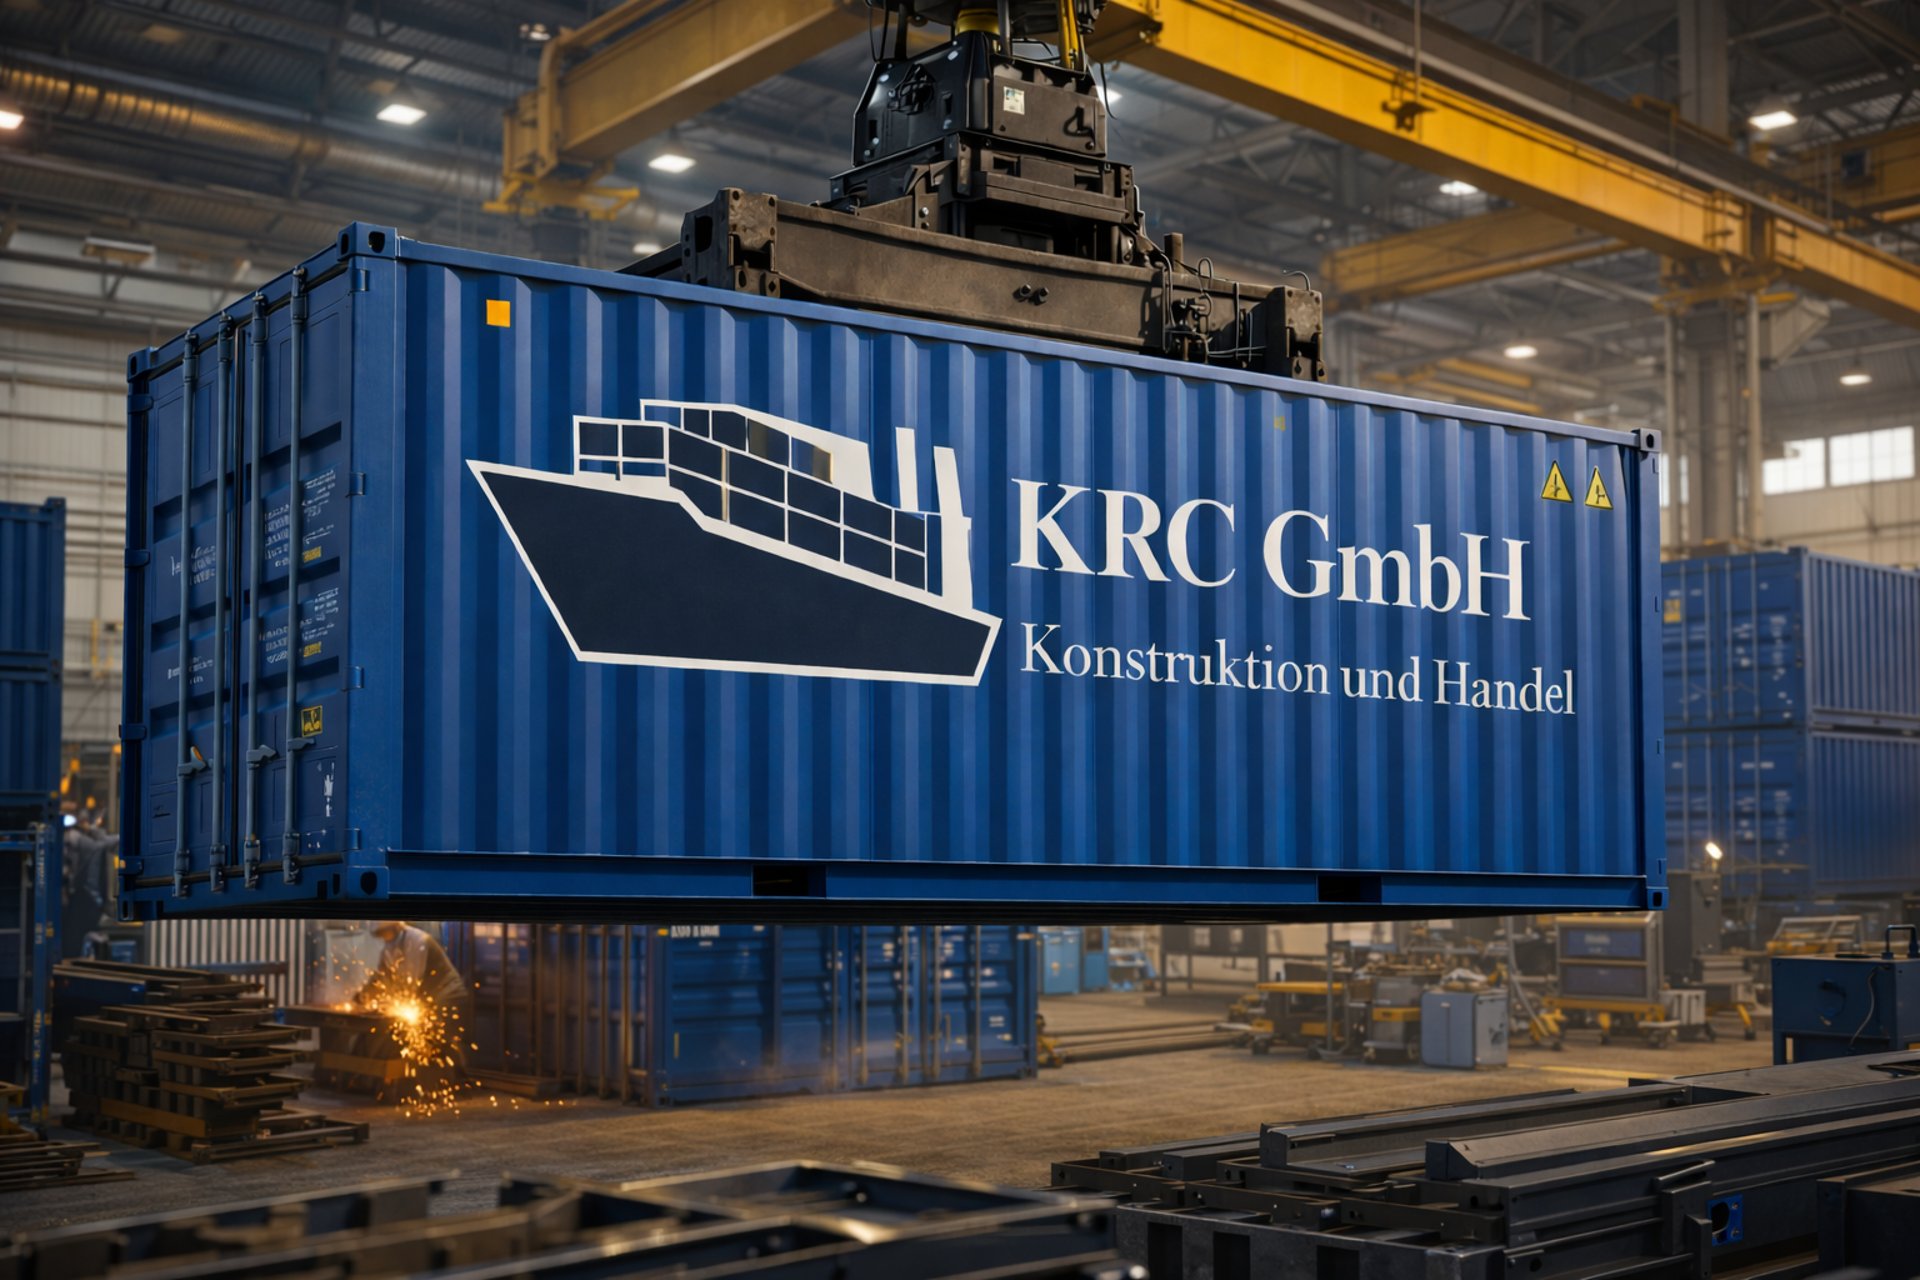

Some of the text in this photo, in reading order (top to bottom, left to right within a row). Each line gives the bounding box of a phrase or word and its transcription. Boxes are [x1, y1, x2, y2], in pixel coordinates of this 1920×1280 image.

[1011, 478, 1531, 621] KRC GmbH
[1020, 622, 1576, 715] Konstruktion und Handel
